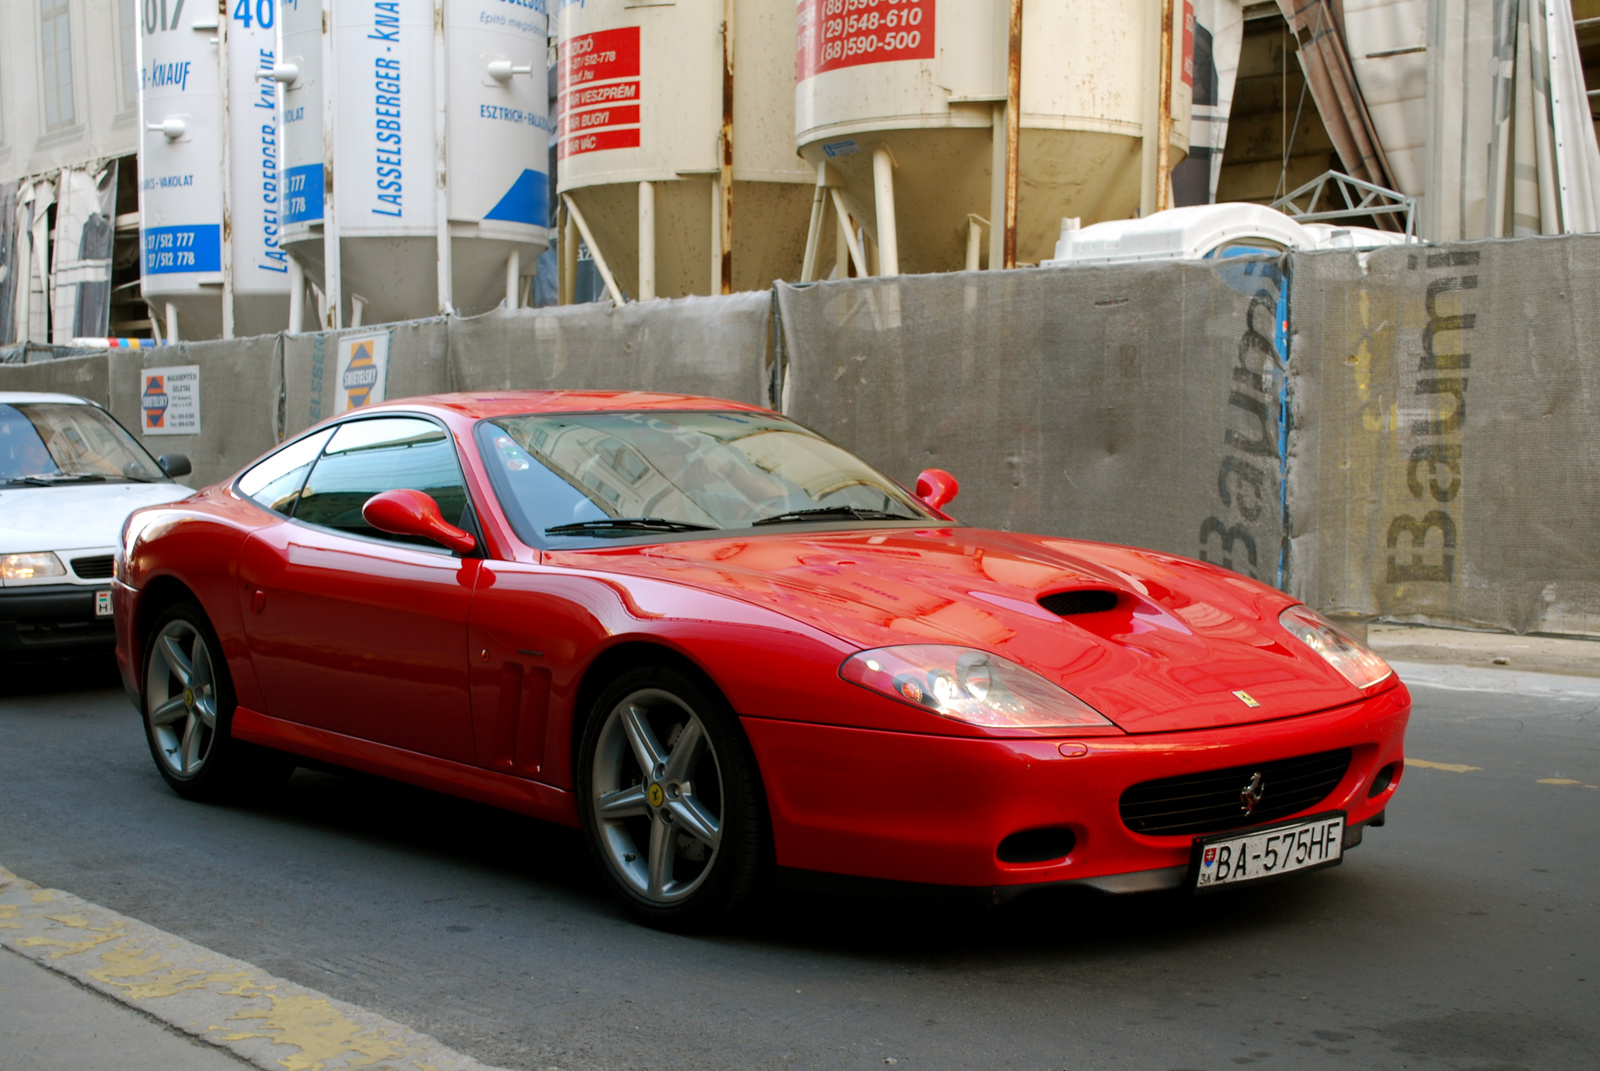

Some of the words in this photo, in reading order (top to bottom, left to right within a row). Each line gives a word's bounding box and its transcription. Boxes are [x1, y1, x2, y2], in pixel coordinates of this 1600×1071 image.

[821, 7, 923, 43] (29)548-610
[820, 30, 921, 65] (88)590-500
[152, 59, 191, 91] KNAUF
[480, 104, 523, 124] ESZTRICH
[371, 57, 403, 217] LASSELSBERGER
[160, 174, 194, 188] VAKOLAT
[176, 232, 195, 247] 777
[176, 252, 196, 267] 778
[344, 367, 377, 387] SWIETELSKY
[1386, 250, 1481, 584] Baumi
[1214, 821, 1341, 882] BA-575HF
